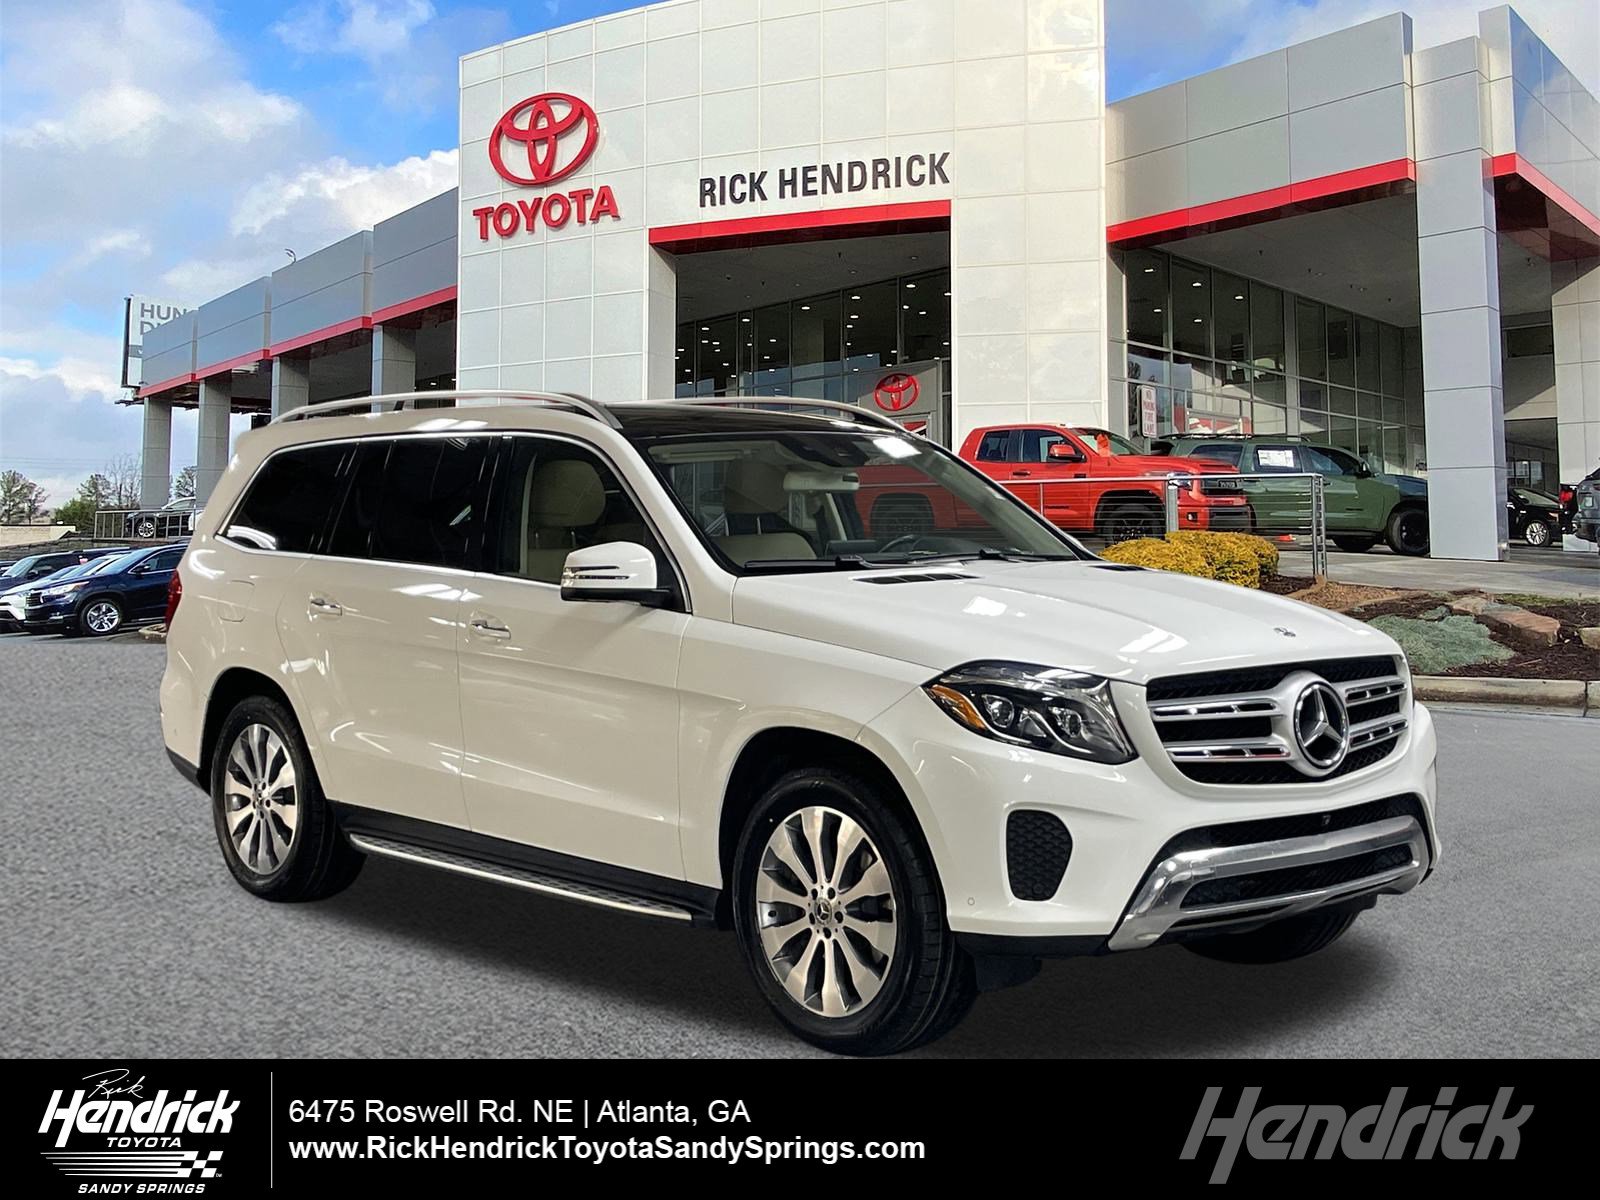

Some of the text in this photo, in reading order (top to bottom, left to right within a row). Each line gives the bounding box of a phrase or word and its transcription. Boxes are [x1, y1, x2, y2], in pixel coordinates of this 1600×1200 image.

[699, 152, 950, 208] RICK HENDRICK
[472, 185, 621, 241] TOYOTA
